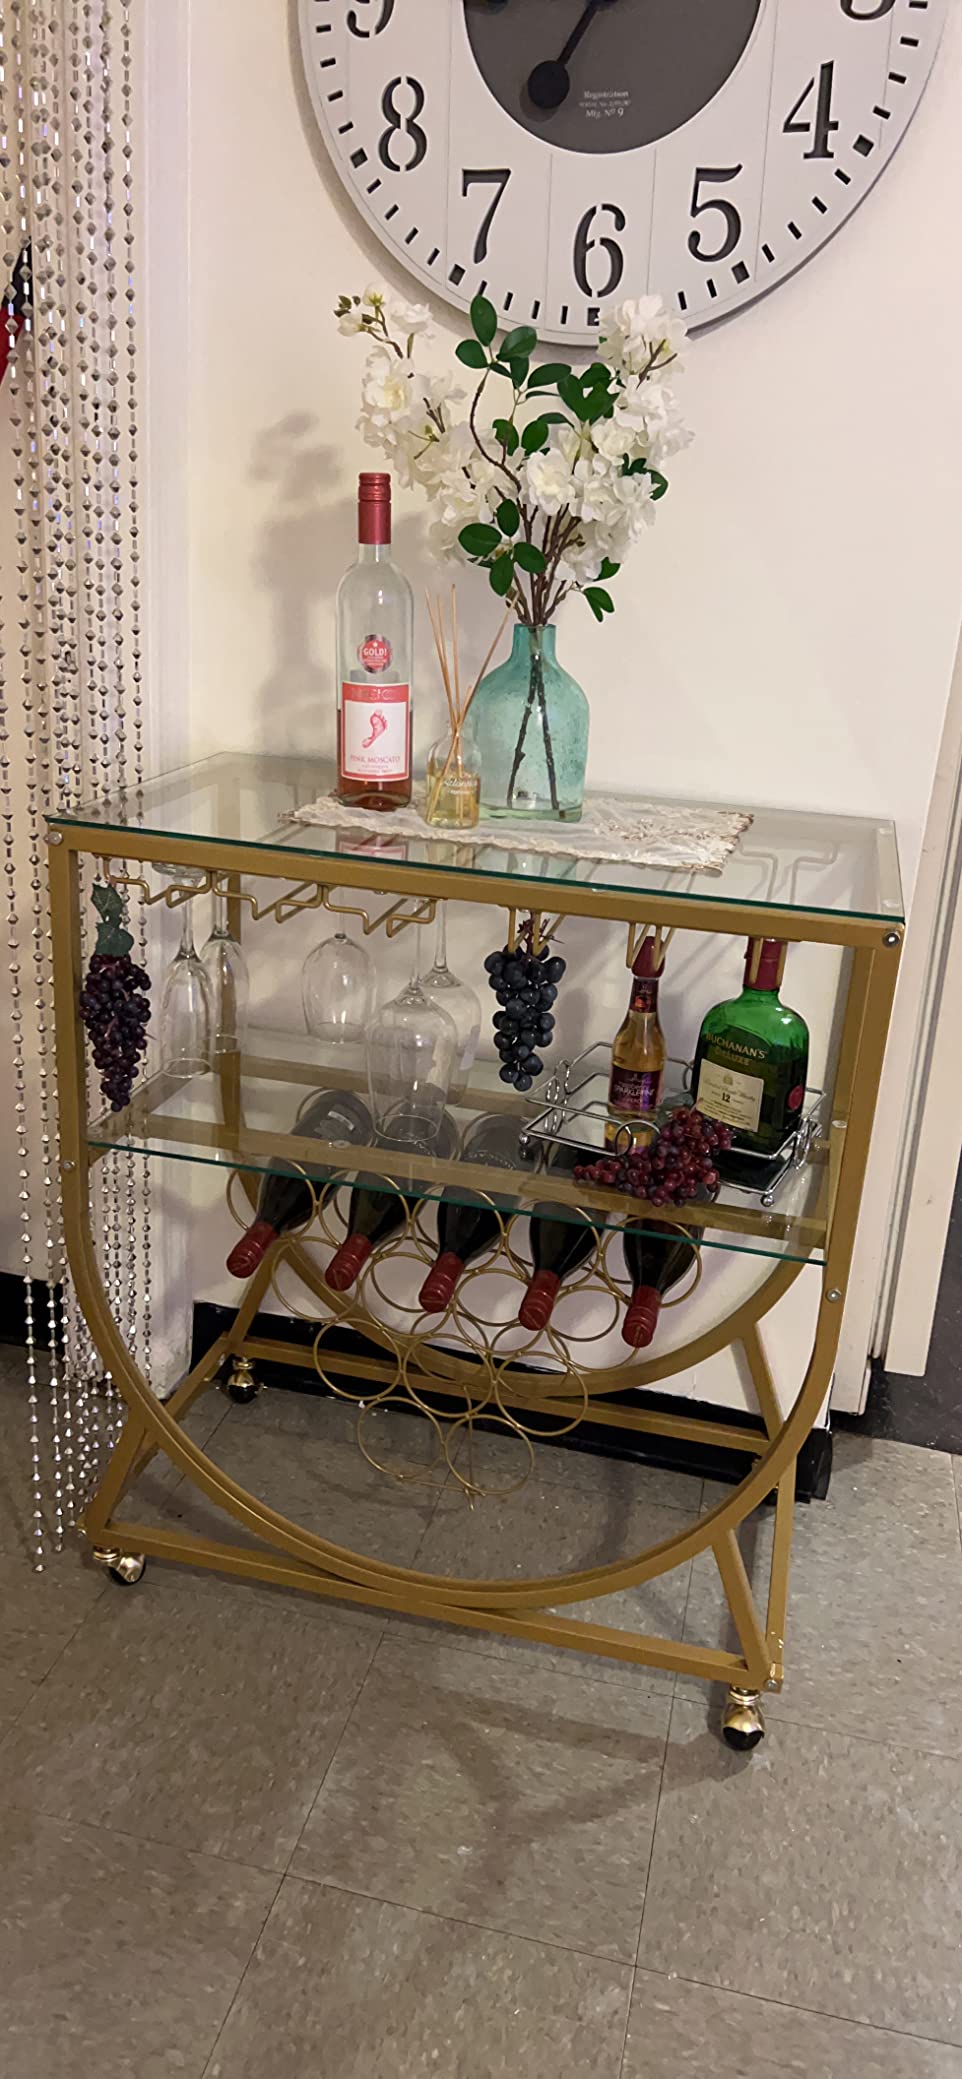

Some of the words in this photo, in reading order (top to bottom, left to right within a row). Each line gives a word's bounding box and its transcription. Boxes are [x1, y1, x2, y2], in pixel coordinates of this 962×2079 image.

[378, 76, 428, 172] 8
[782, 60, 839, 160] 4
[461, 168, 511, 264] 7
[573, 203, 626, 298] 6
[688, 164, 744, 262] 5
